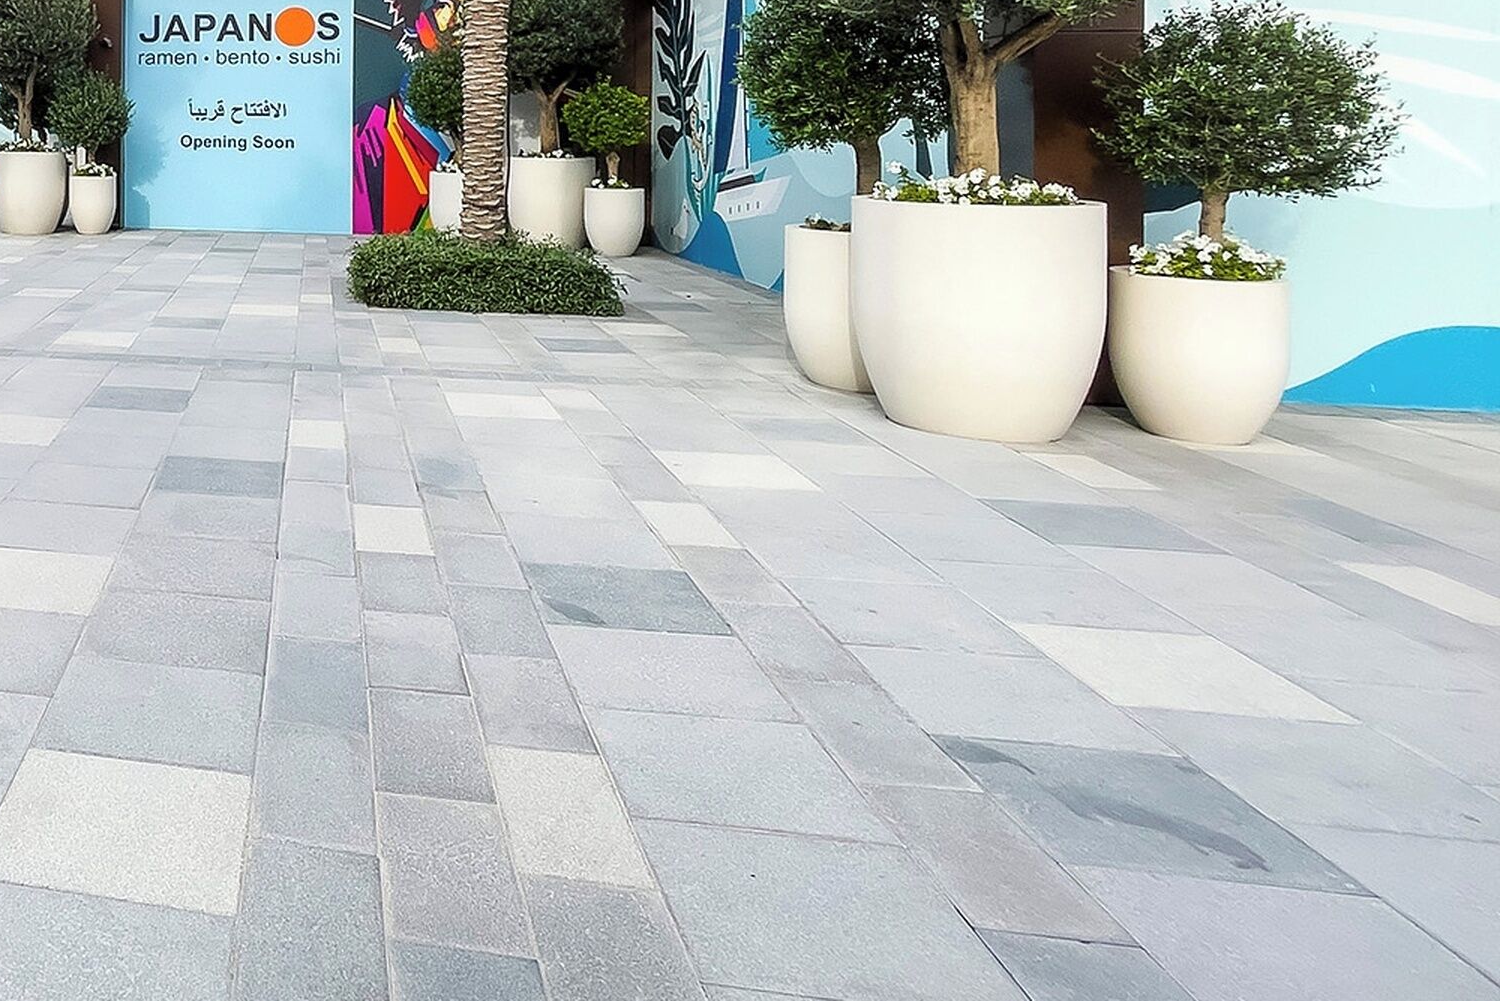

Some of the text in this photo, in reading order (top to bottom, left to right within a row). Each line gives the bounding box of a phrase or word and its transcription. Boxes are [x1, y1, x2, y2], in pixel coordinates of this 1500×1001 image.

[138, 7, 340, 46] JAPANOS
[138, 48, 341, 65] ramen bento sushi
[230, 100, 287, 124] الافتتاح
[180, 135, 295, 151] Opening Soon
